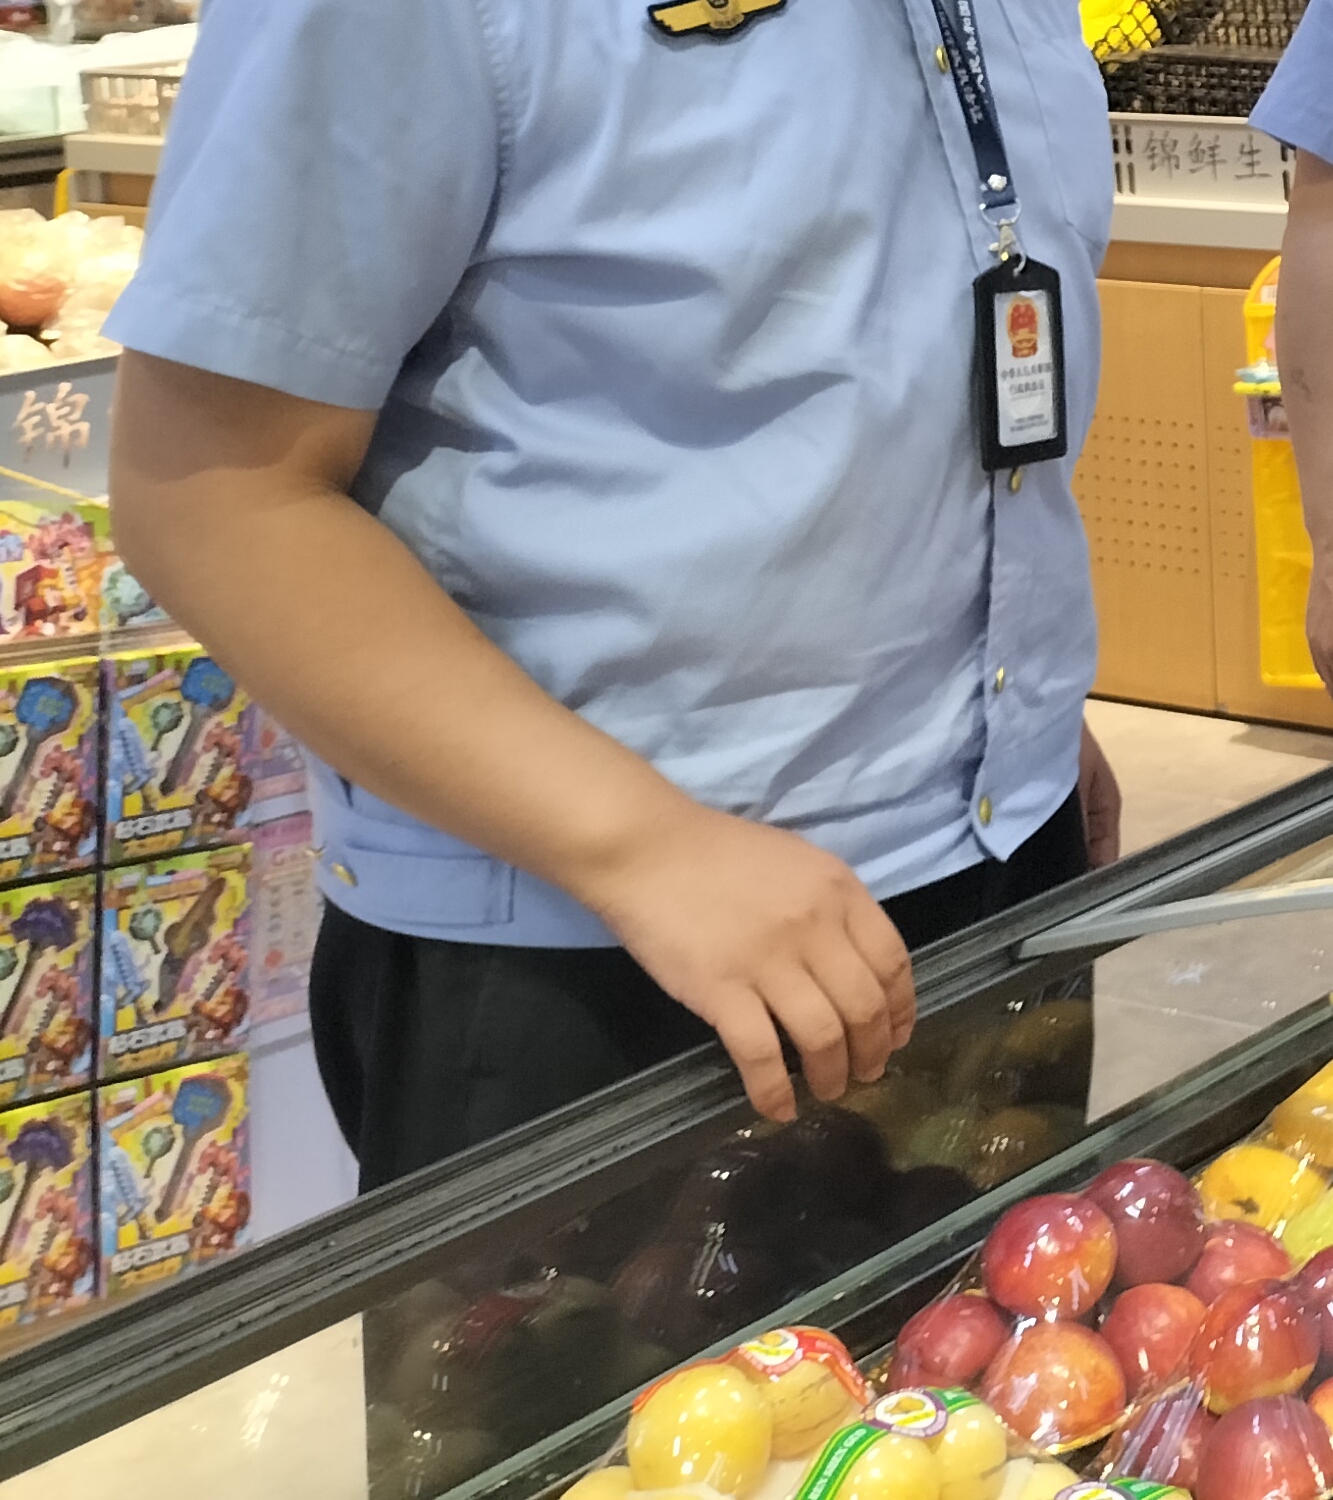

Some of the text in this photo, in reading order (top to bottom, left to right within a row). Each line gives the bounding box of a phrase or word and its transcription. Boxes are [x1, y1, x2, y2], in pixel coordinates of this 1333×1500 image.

[1143, 129, 1273, 181] 锦鲜生
[12, 380, 92, 468] 锦
